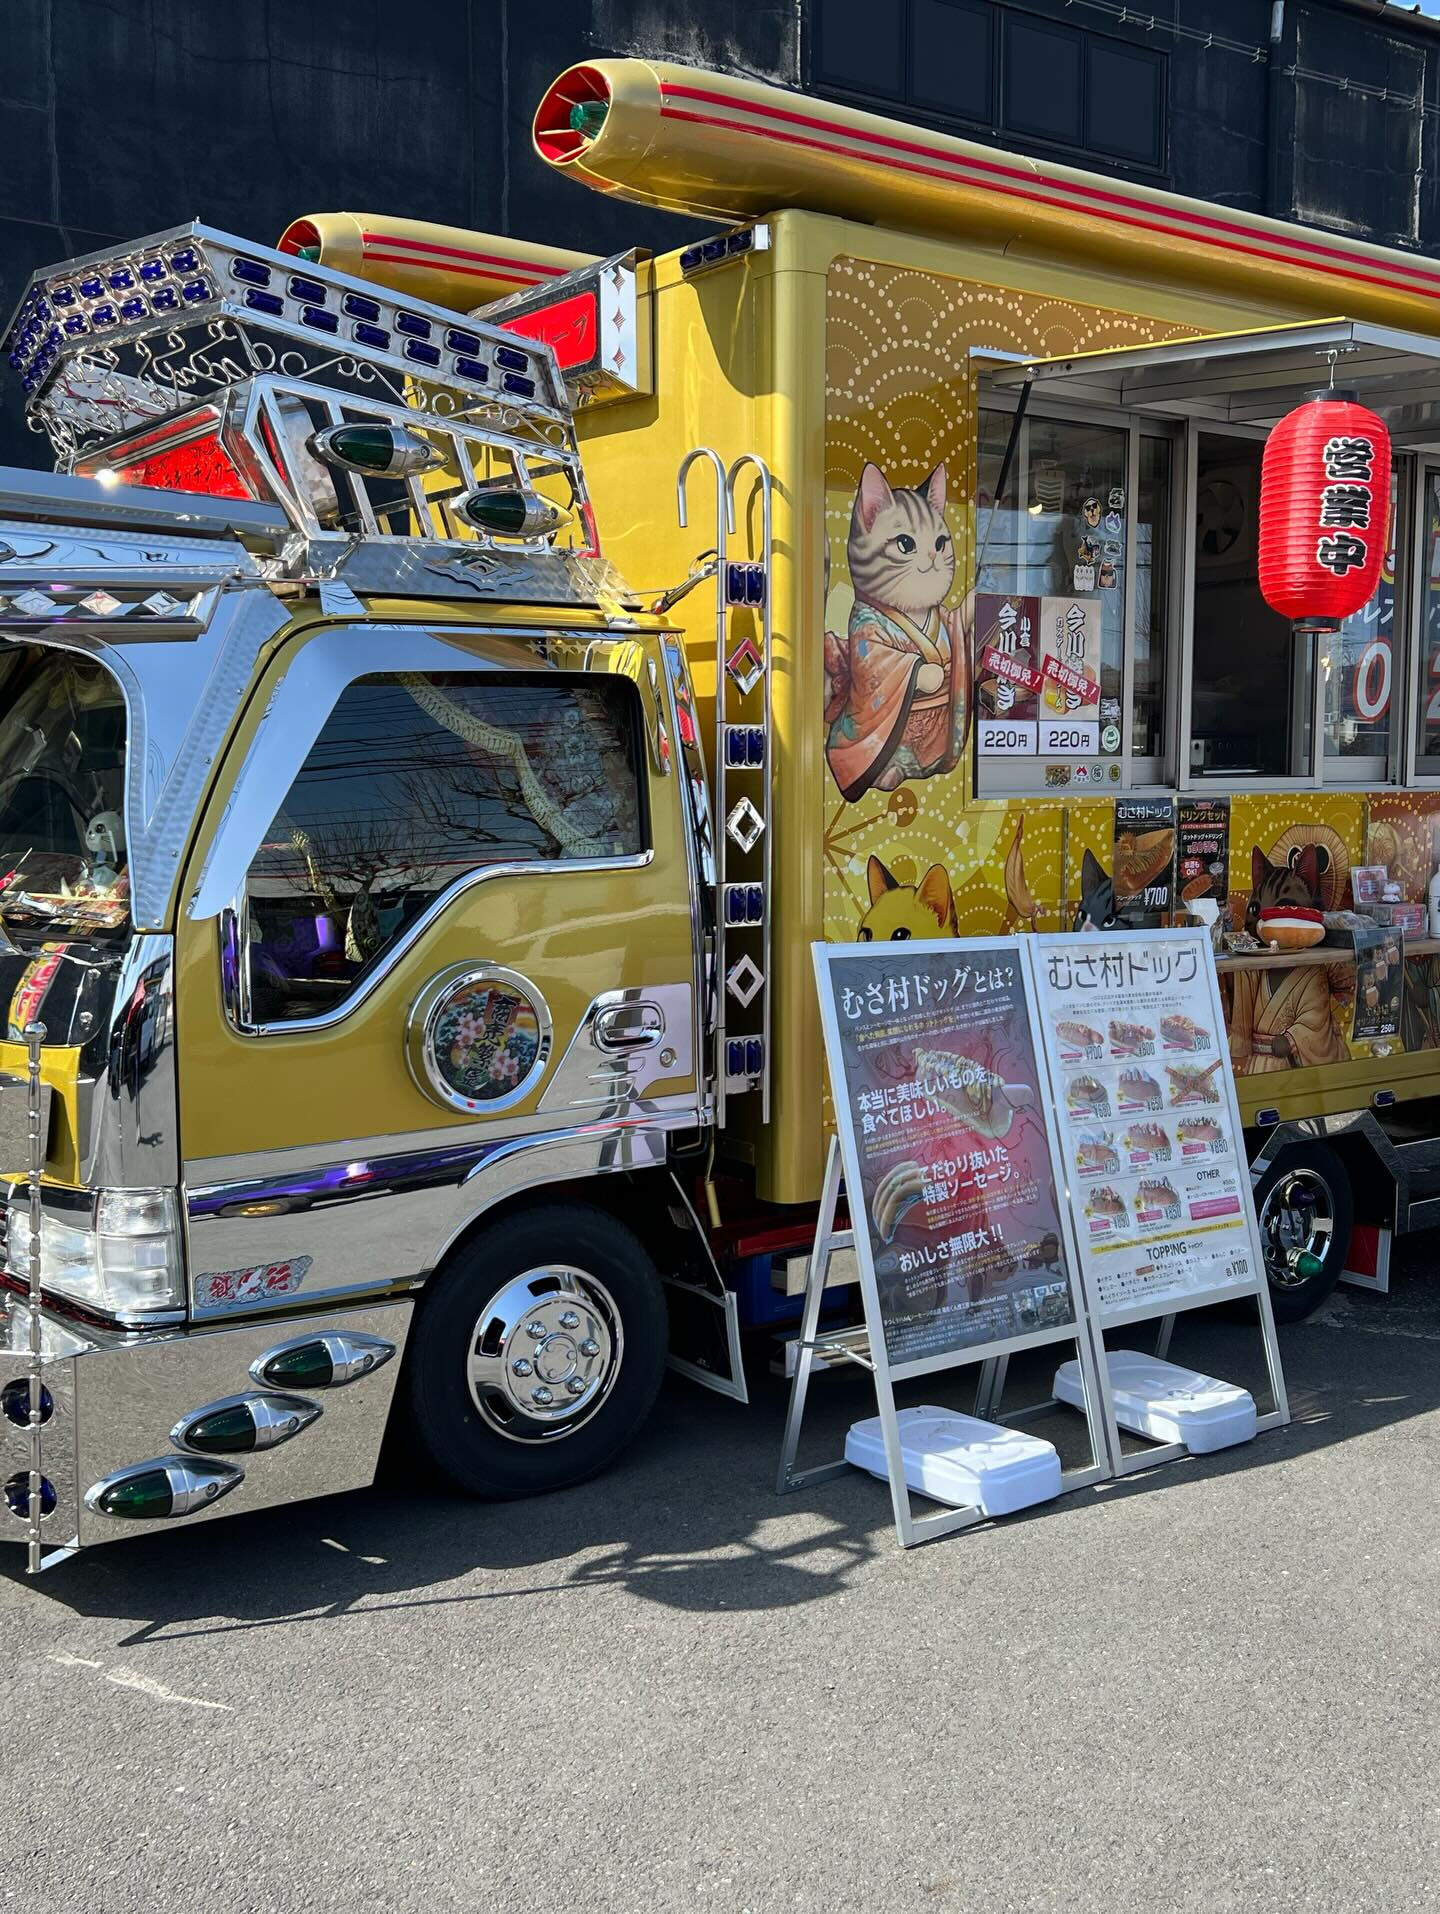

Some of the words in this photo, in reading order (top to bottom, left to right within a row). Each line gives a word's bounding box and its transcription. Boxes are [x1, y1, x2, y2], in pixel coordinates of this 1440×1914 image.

[1317, 437, 1375, 576] 営業中
[984, 731, 1027, 748] 220円
[1049, 731, 1090, 748] 220円
[1118, 805, 1172, 819] むさ村ドッグ
[1144, 886, 1168, 906] ¥700
[1048, 948, 1198, 990] むさ村ドッグ
[841, 966, 1013, 1019] むさ村ドッグとは?
[861, 1099, 947, 1135] 食べてほしい。
[1209, 1138, 1228, 1155] ¥850
[920, 1146, 1008, 1183] こだわり抜いた
[922, 1163, 1020, 1205] 特製ソーセージ。
[1197, 1169, 1220, 1181] OTHER
[1146, 1242, 1187, 1260] TOPPING
[1231, 1258, 1249, 1276] ¥100
